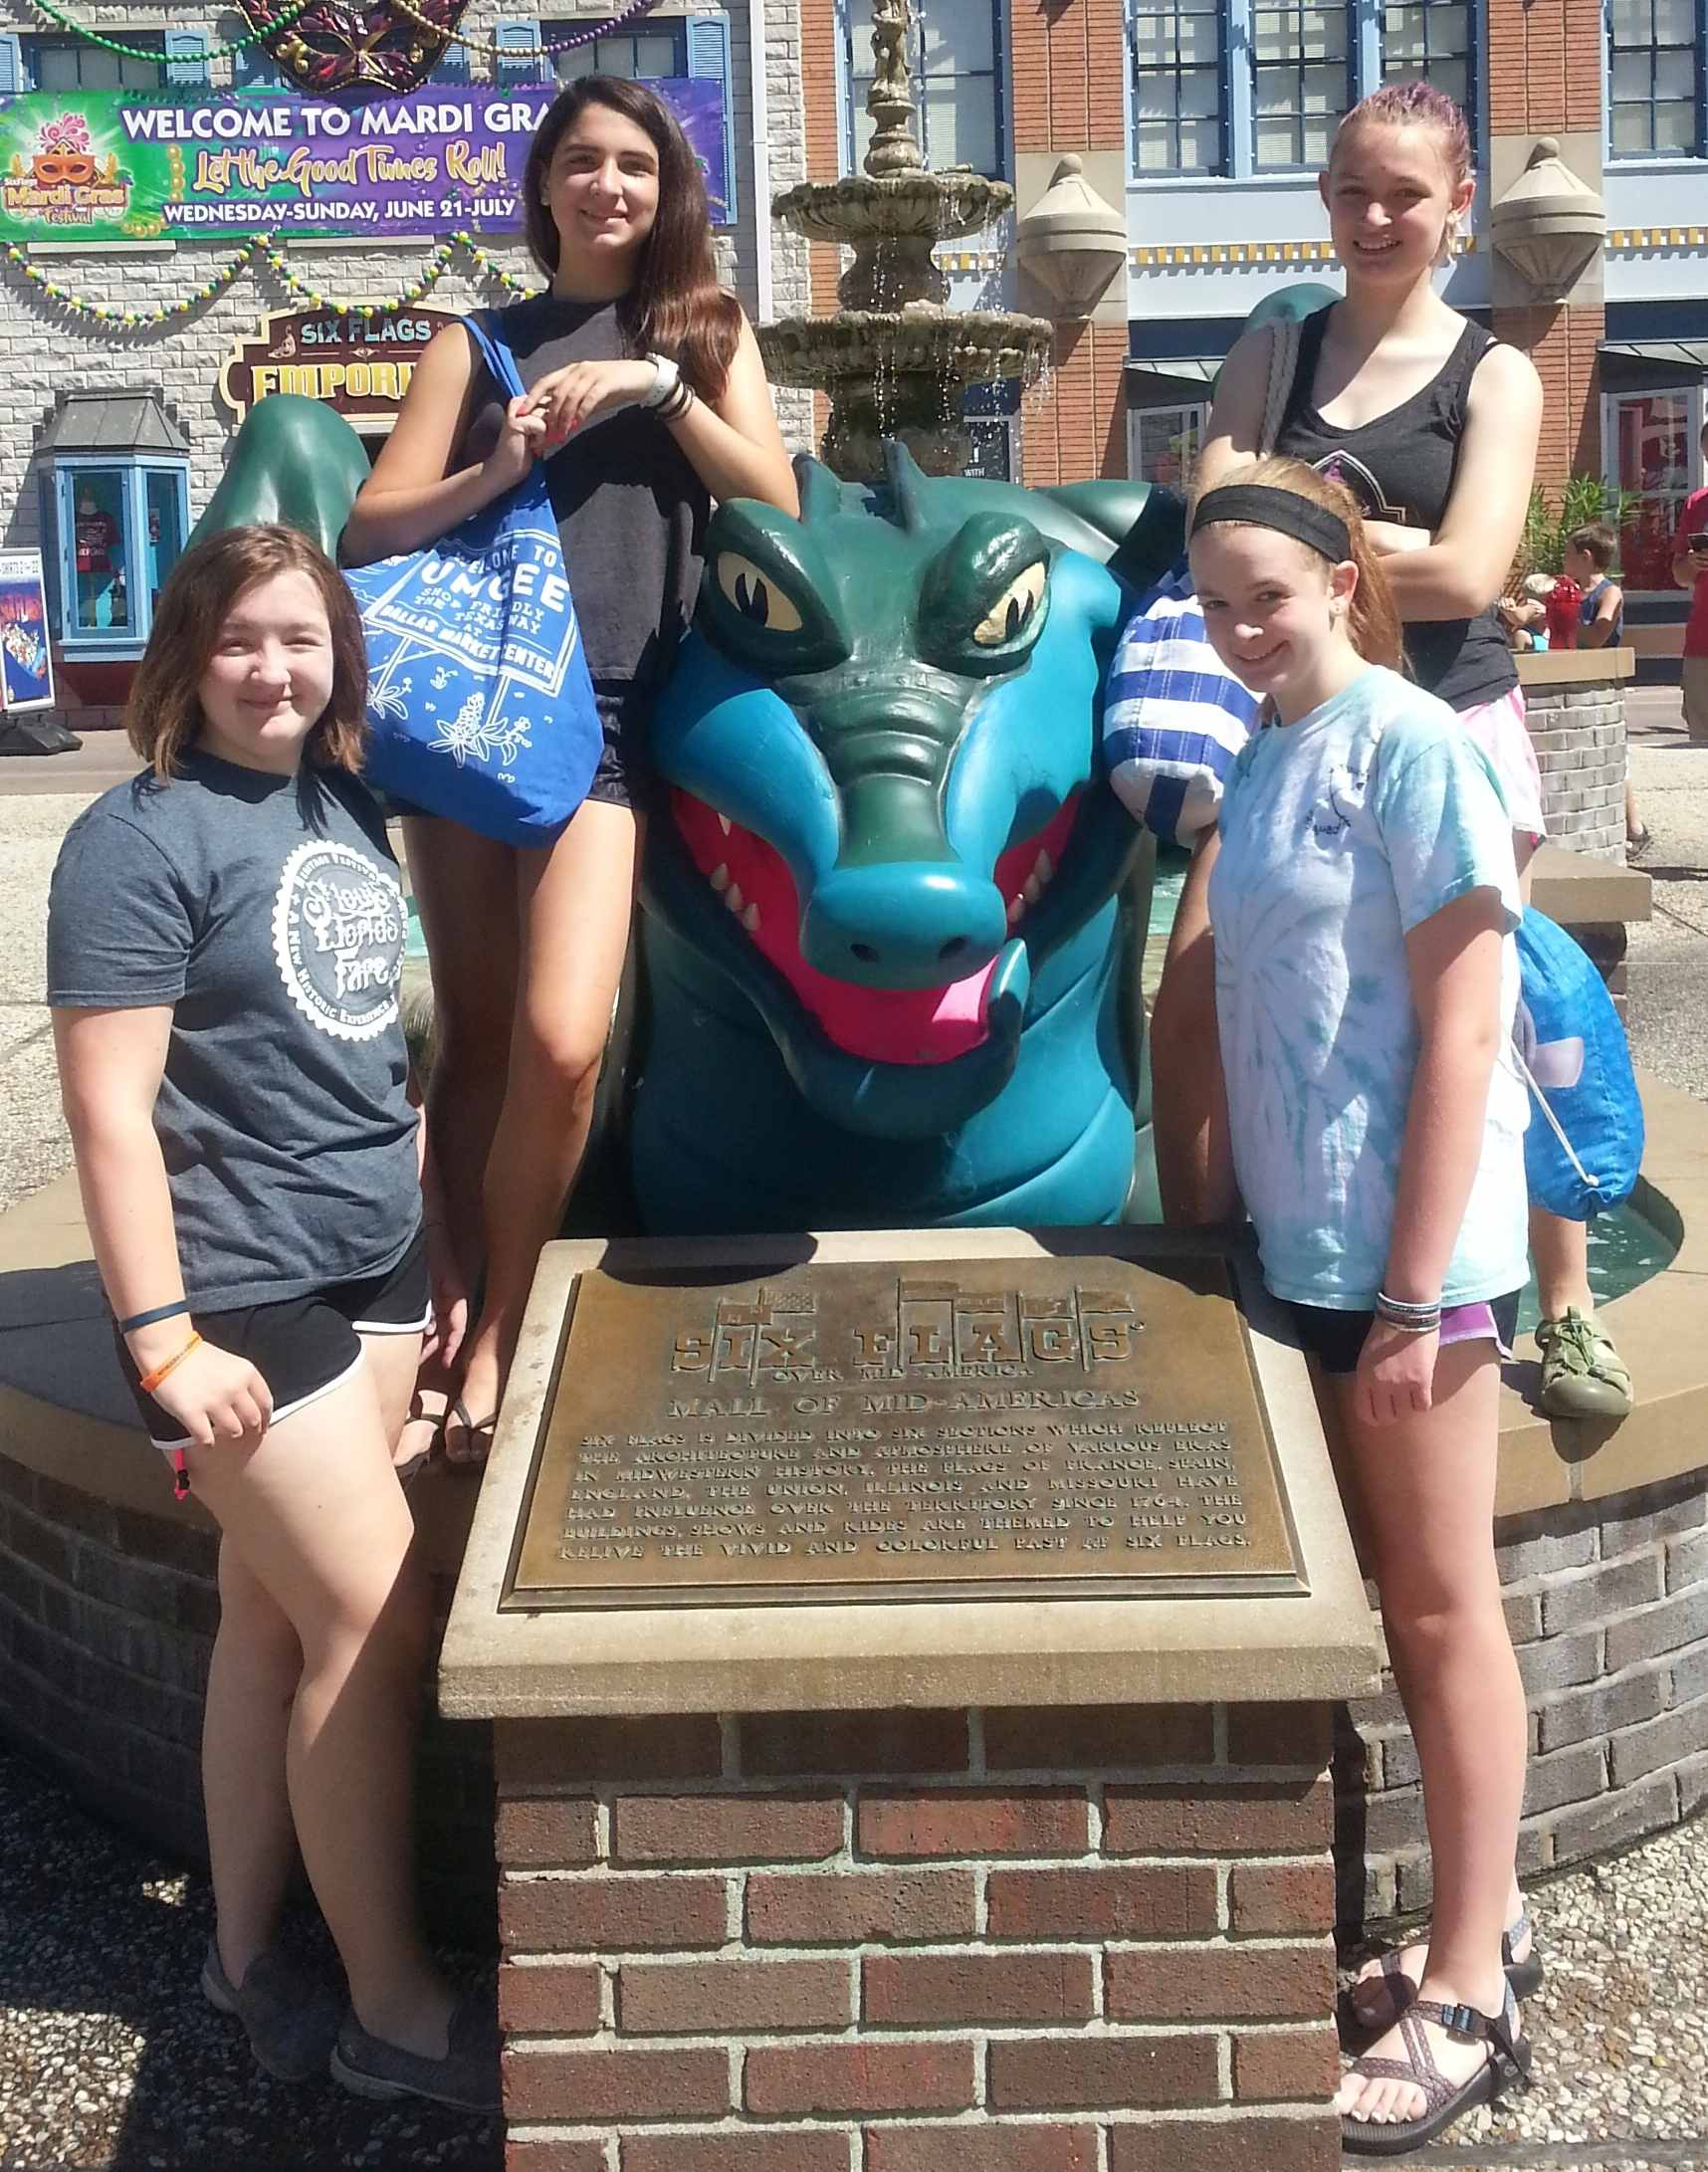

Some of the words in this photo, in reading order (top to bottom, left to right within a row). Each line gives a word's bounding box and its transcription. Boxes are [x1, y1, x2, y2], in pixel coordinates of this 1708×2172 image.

[121, 107, 293, 139] WELCOME
[301, 107, 351, 136] TO
[359, 103, 474, 135] MARDI
[192, 148, 232, 194] Let
[232, 148, 281, 190] the
[278, 146, 360, 197] Good
[355, 142, 438, 185] Times
[445, 140, 507, 187] Roll!
[7, 185, 72, 206] Mardi
[74, 185, 124, 206] Gras
[163, 201, 380, 223] WEDNESDAY-SUNDAY,
[384, 199, 435, 219] JUNE
[441, 198, 516, 218] 21-JULY
[301, 319, 342, 344] SIX
[348, 318, 431, 342] FLAGS
[534, 544, 557, 568] TO
[379, 603, 439, 633] DALLAS
[438, 627, 501, 661] MARKET
[503, 642, 556, 680] ENTER
[670, 1328, 817, 1372] SIX
[772, 1371, 843, 1384] OVER
[668, 1396, 767, 1418] MALL
[792, 1395, 841, 1414] OF
[862, 1389, 1141, 1415] MID-AMERICAS
[699, 1431, 715, 1443] IS
[725, 1428, 813, 1444] DIVIDED
[937, 1423, 1036, 1439] SECTIONS
[1047, 1422, 1123, 1437] WHICH
[1135, 1420, 1228, 1435] REFLECT
[812, 1446, 862, 1460] AND
[1022, 1442, 1053, 1455] OF
[1067, 1440, 1163, 1454] VARIOUS
[1174, 1438, 1231, 1452] ERAS
[573, 1469, 599, 1482] IN
[614, 1465, 762, 1483] MIDWESTERN
[887, 1462, 929, 1475] THE
[942, 1460, 1007, 1474] FLAGS
[1022, 1460, 1051, 1472] OF
[707, 1485, 750, 1498] THE
[863, 1480, 963, 1493] ILLINOIS
[979, 1478, 1031, 1492] AND
[1048, 1476, 1159, 1491] MISSOURI
[1176, 1474, 1239, 1488] HAVE
[566, 1506, 616, 1520] HAD
[634, 1504, 756, 1519] INFLUENCE
[768, 1501, 835, 1515] OVER
[847, 1500, 892, 1513] THE
[905, 1496, 1037, 1512] TERRITORY
[1050, 1495, 1118, 1510] SINCE
[1200, 1494, 1243, 1507] THE
[689, 1522, 765, 1537] SHOWS
[777, 1521, 828, 1535] AND
[843, 1519, 907, 1533] RIDES
[920, 1518, 965, 1532] ARE
[979, 1515, 1071, 1531] THEMED
[1082, 1515, 1115, 1528] TO
[1130, 1513, 1187, 1528] HELP
[1198, 1513, 1247, 1526] YOU
[557, 1544, 645, 1561] RELIVE
[660, 1543, 704, 1558] THE
[720, 1542, 792, 1556] VIVID
[803, 1540, 858, 1556] AND
[875, 1538, 1000, 1554] COLORFUL
[1013, 1536, 1069, 1551] PAST
[1081, 1535, 1110, 1551] AT
[1125, 1534, 1164, 1550] SIX
